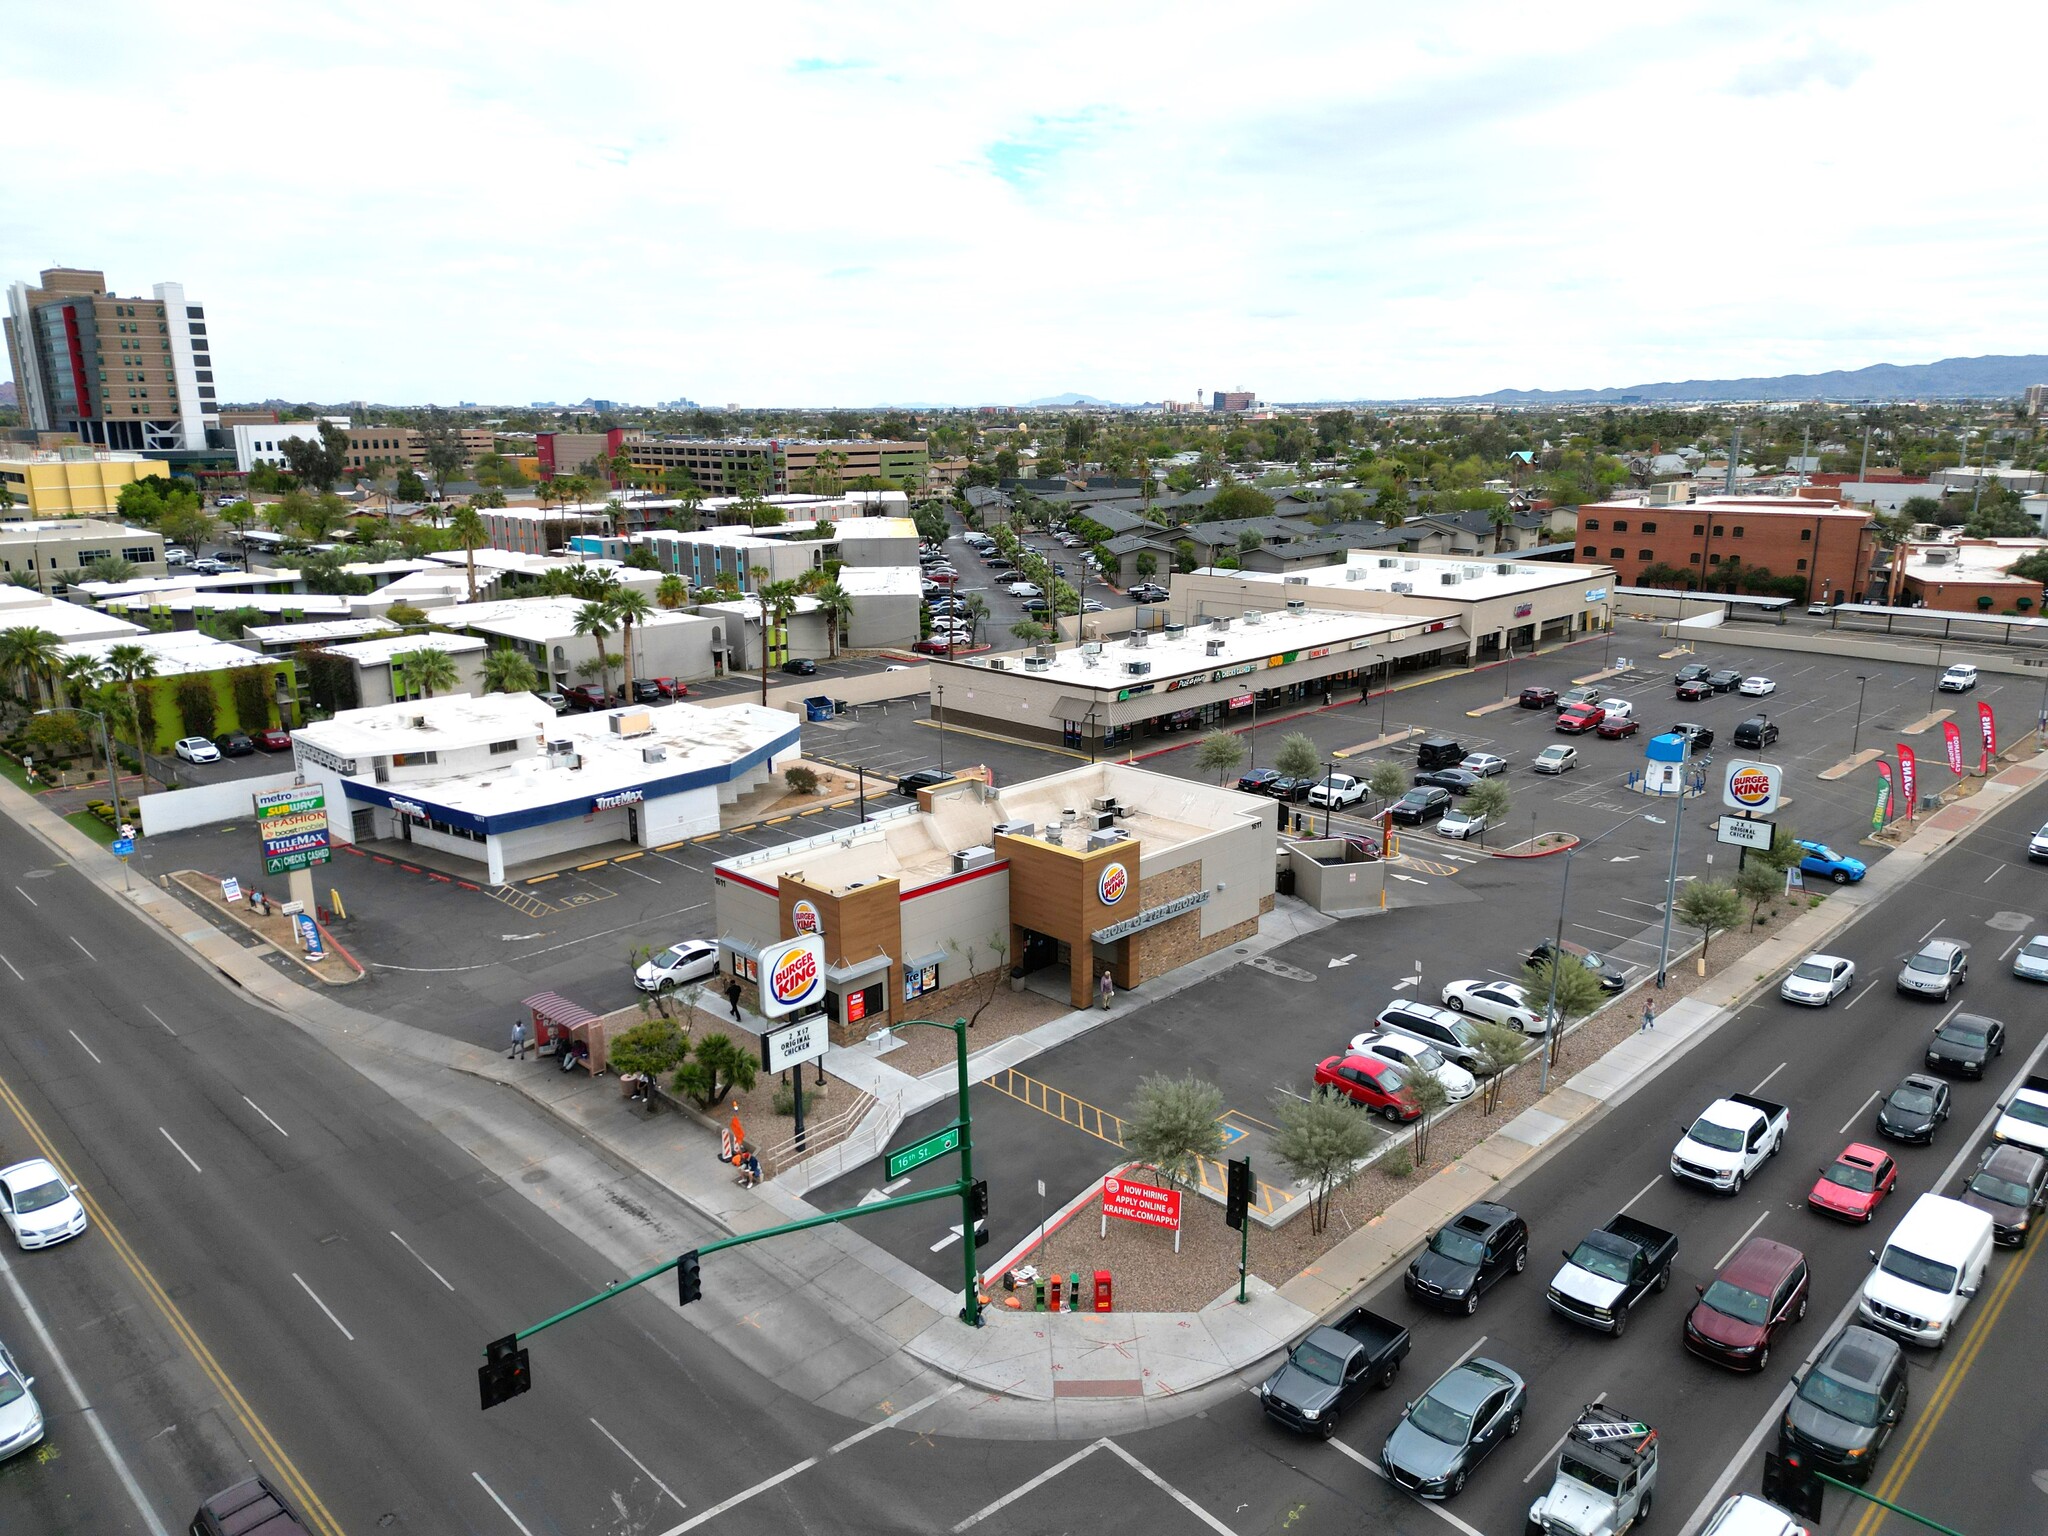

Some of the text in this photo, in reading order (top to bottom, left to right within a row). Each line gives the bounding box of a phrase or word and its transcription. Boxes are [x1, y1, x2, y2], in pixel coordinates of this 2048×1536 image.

[1734, 776, 1769, 785] BURGER
[1734, 783, 1769, 796] KING
[260, 793, 292, 804] metro
[267, 800, 317, 817] SUBWAY
[262, 812, 326, 830] K-FASHION
[1729, 831, 1753, 839] CHICKEN
[1730, 826, 1755, 835] ORIGINAL
[283, 853, 306, 866] CHECKS
[307, 848, 330, 860] CASHED
[1104, 869, 1124, 890] BURGER
[1105, 875, 1125, 898] KING
[796, 912, 815, 920] BURGER
[797, 920, 816, 930] KING
[775, 952, 813, 986] BURGER
[778, 961, 816, 999] KING
[780, 1034, 811, 1050] ORIGINAL
[784, 1042, 810, 1056] CHICKEN
[898, 1154, 915, 1168] 16th
[1123, 1185, 1142, 1196] NOW
[1143, 1189, 1168, 1202] HIRING
[1115, 1195, 1138, 1206] APPLY
[1139, 1200, 1166, 1213] ONLINE
[1103, 1203, 1179, 1226] KRAFINC.COM/APPLY
